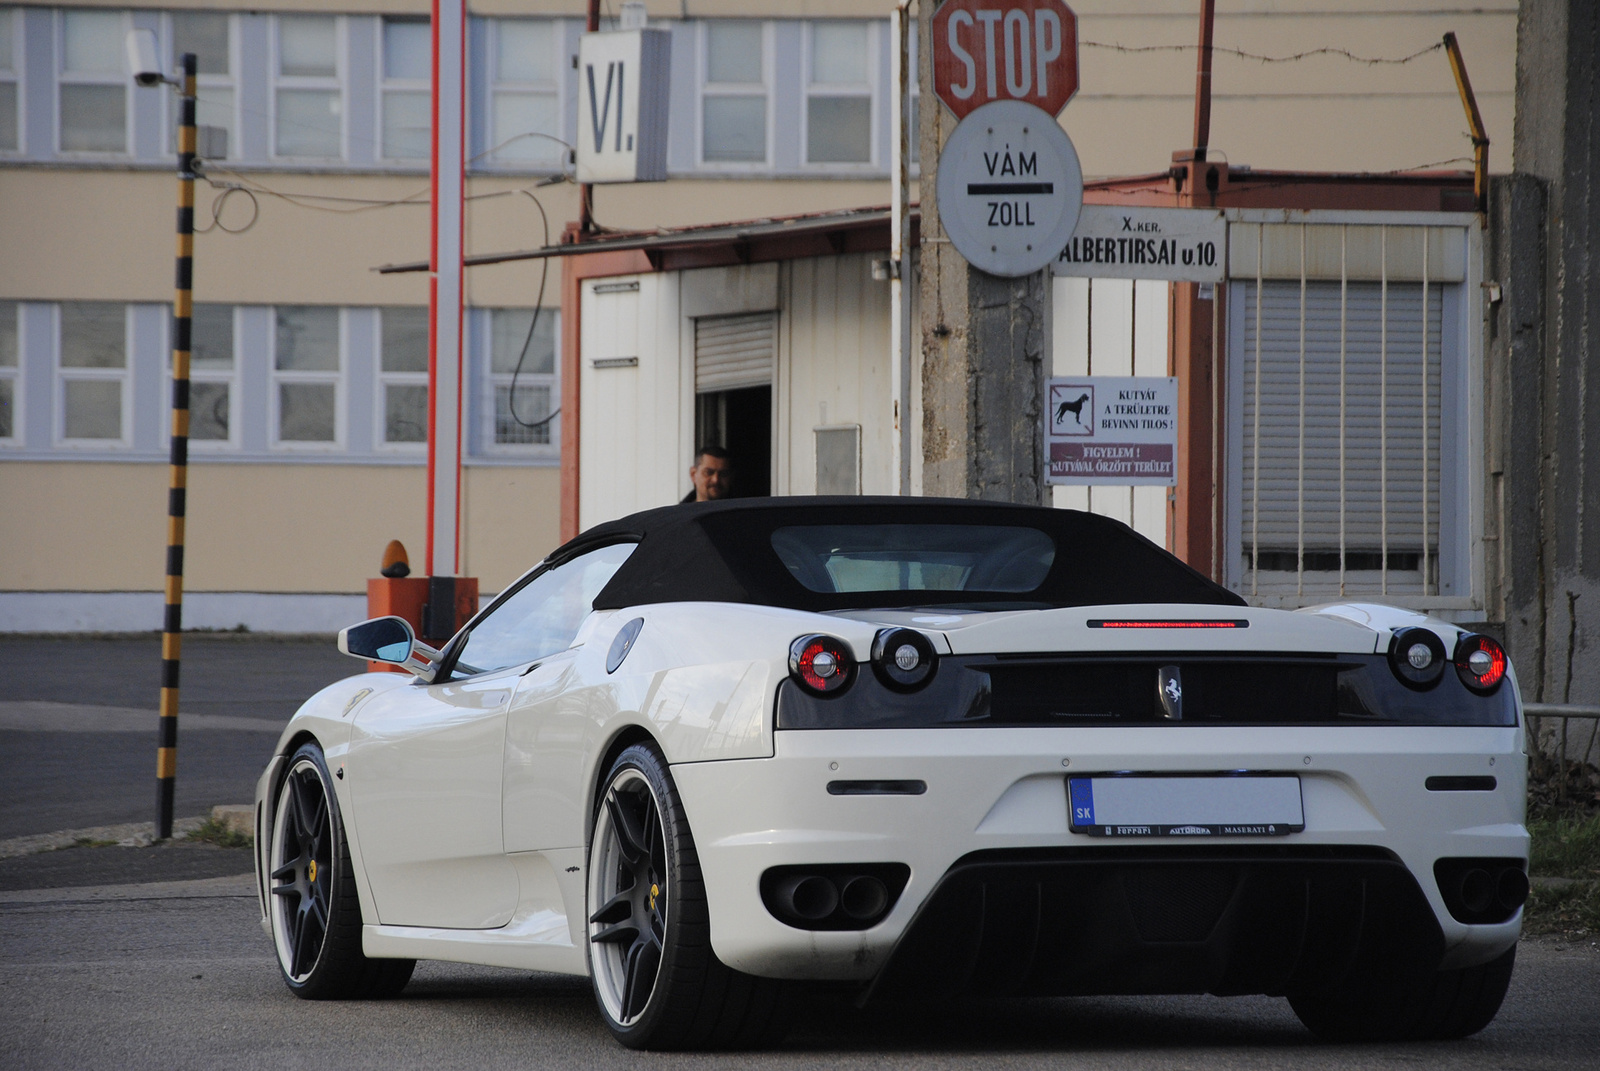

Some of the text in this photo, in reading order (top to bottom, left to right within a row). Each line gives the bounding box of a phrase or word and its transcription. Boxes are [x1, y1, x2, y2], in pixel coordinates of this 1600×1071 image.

[948, 9, 1061, 98] STOP
[587, 61, 633, 153] VI.
[987, 202, 1035, 226] ZOLL
[1059, 237, 1177, 265] ALBERTIRSAI
[1119, 388, 1157, 400] KUTYÁT
[1104, 402, 1171, 415] A TERÜLETRE
[1101, 419, 1139, 429] BEVINNI
[1052, 460, 1094, 472] KUTYÁVAL
[1134, 460, 1171, 473] TERÜLET
[1076, 807, 1091, 819] SK
[1224, 826, 1266, 834] MASERATI
